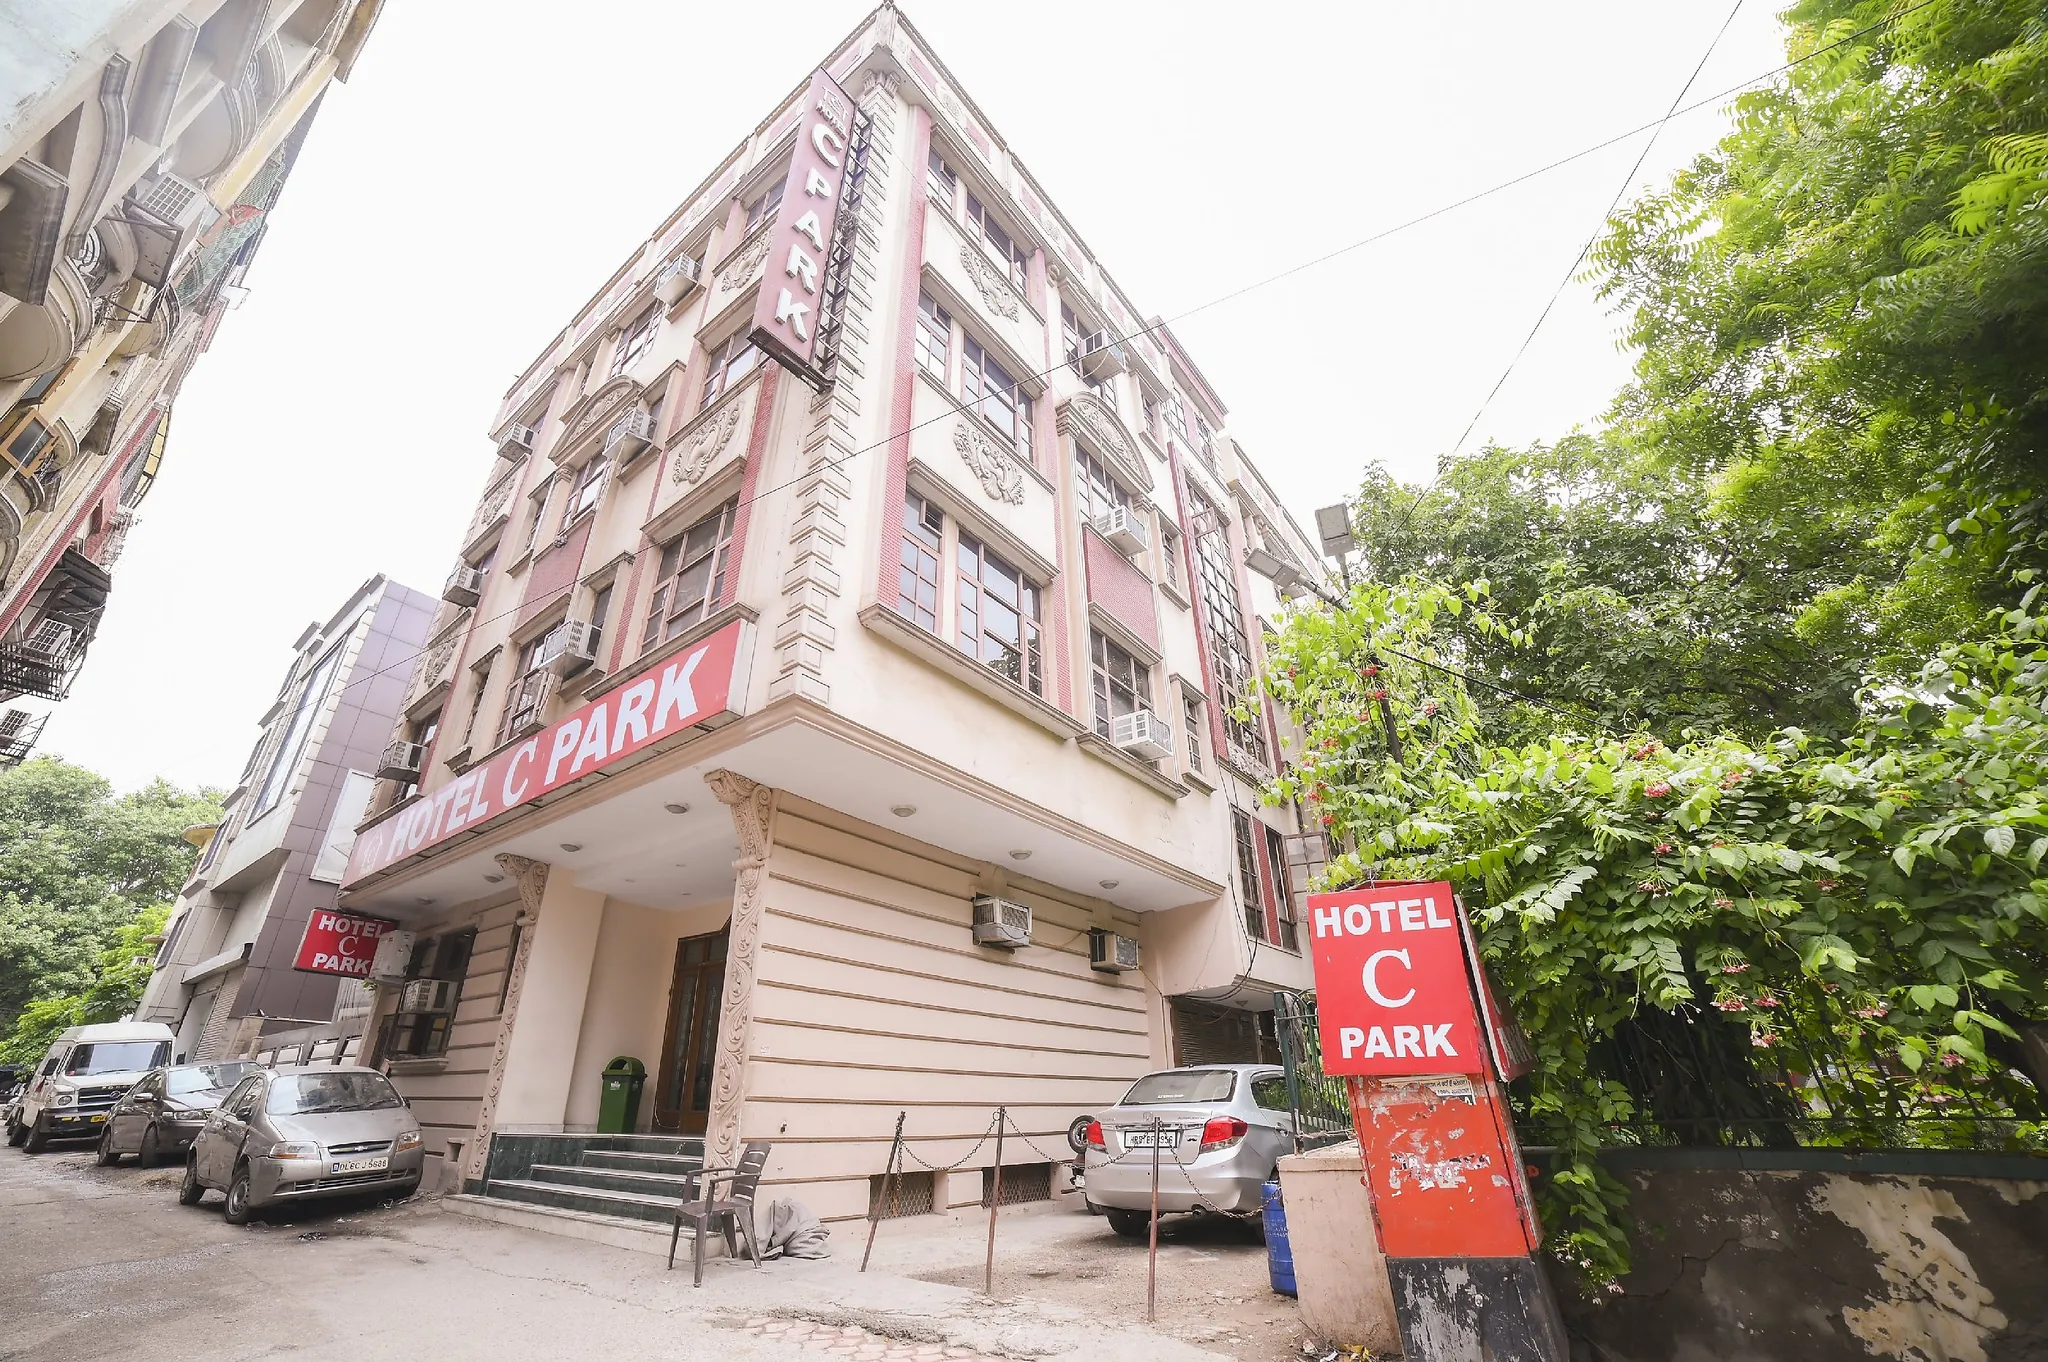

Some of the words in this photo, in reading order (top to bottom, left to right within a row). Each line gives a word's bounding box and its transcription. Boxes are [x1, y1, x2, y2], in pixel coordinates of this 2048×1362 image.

[816, 99, 848, 140] HOTEL
[811, 122, 844, 170] C
[774, 167, 833, 343] PARK
[385, 768, 490, 861] HOTEL
[502, 738, 538, 807] C
[544, 644, 711, 786] PARK
[318, 914, 383, 939] HOTEL
[1314, 896, 1452, 938] HOTEL
[312, 953, 371, 975] PARK
[338, 936, 359, 956] C
[1361, 948, 1416, 1008] C
[1339, 1023, 1459, 1059] PARK
